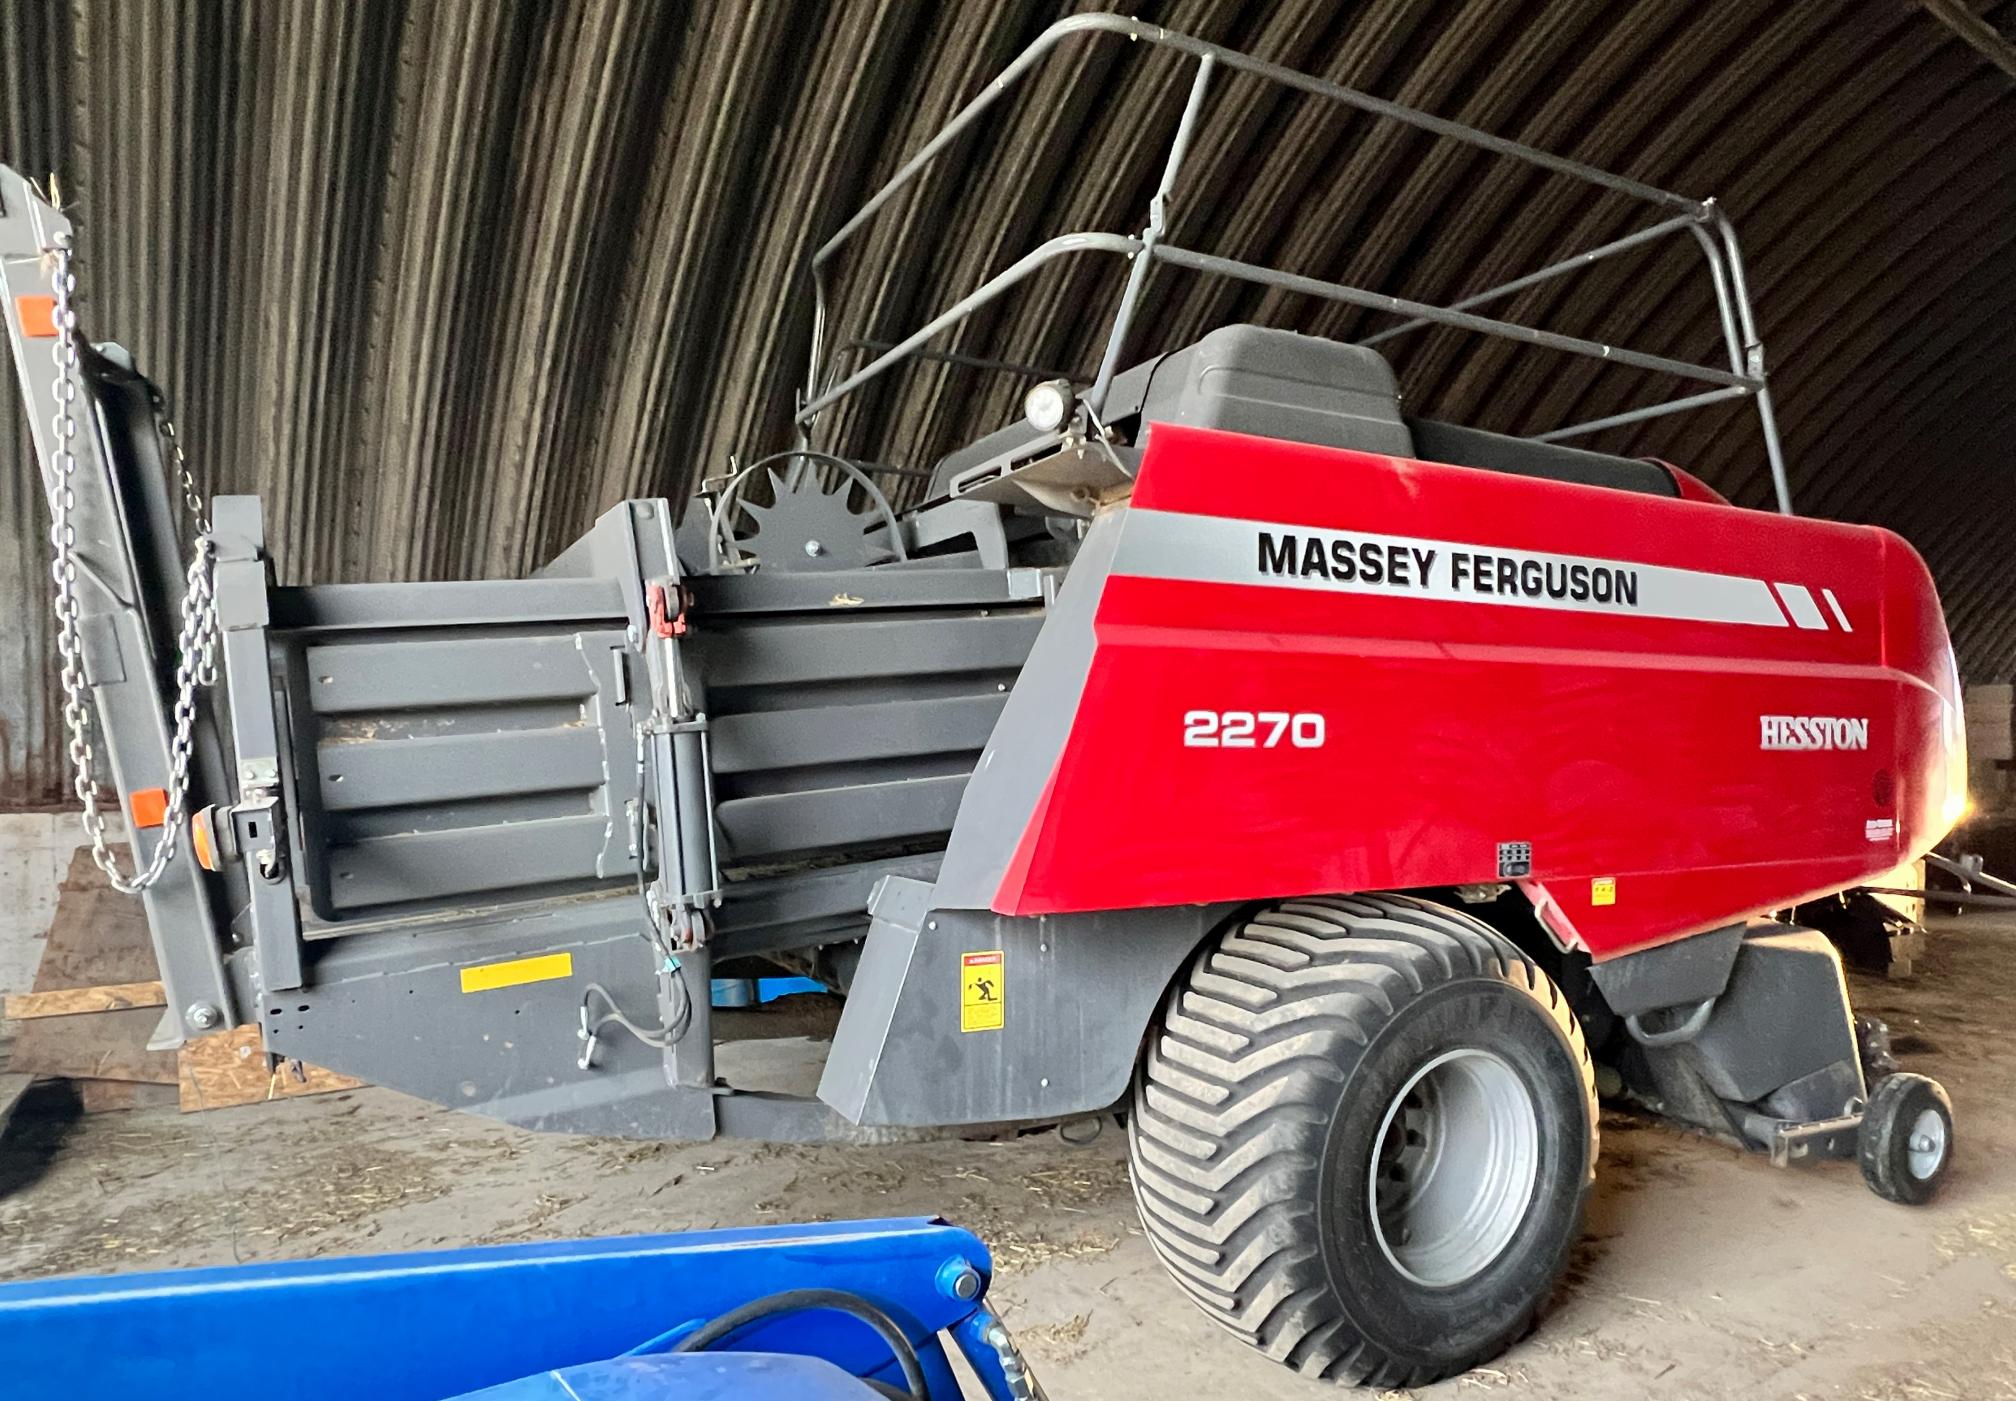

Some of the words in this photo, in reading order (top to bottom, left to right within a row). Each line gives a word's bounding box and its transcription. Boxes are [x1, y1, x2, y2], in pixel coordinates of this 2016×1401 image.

[1258, 532, 1436, 587] MASSEY
[1451, 553, 1638, 605] FERGUSON
[1184, 711, 1326, 748] 2270
[1760, 715, 1868, 751] HESSTON
